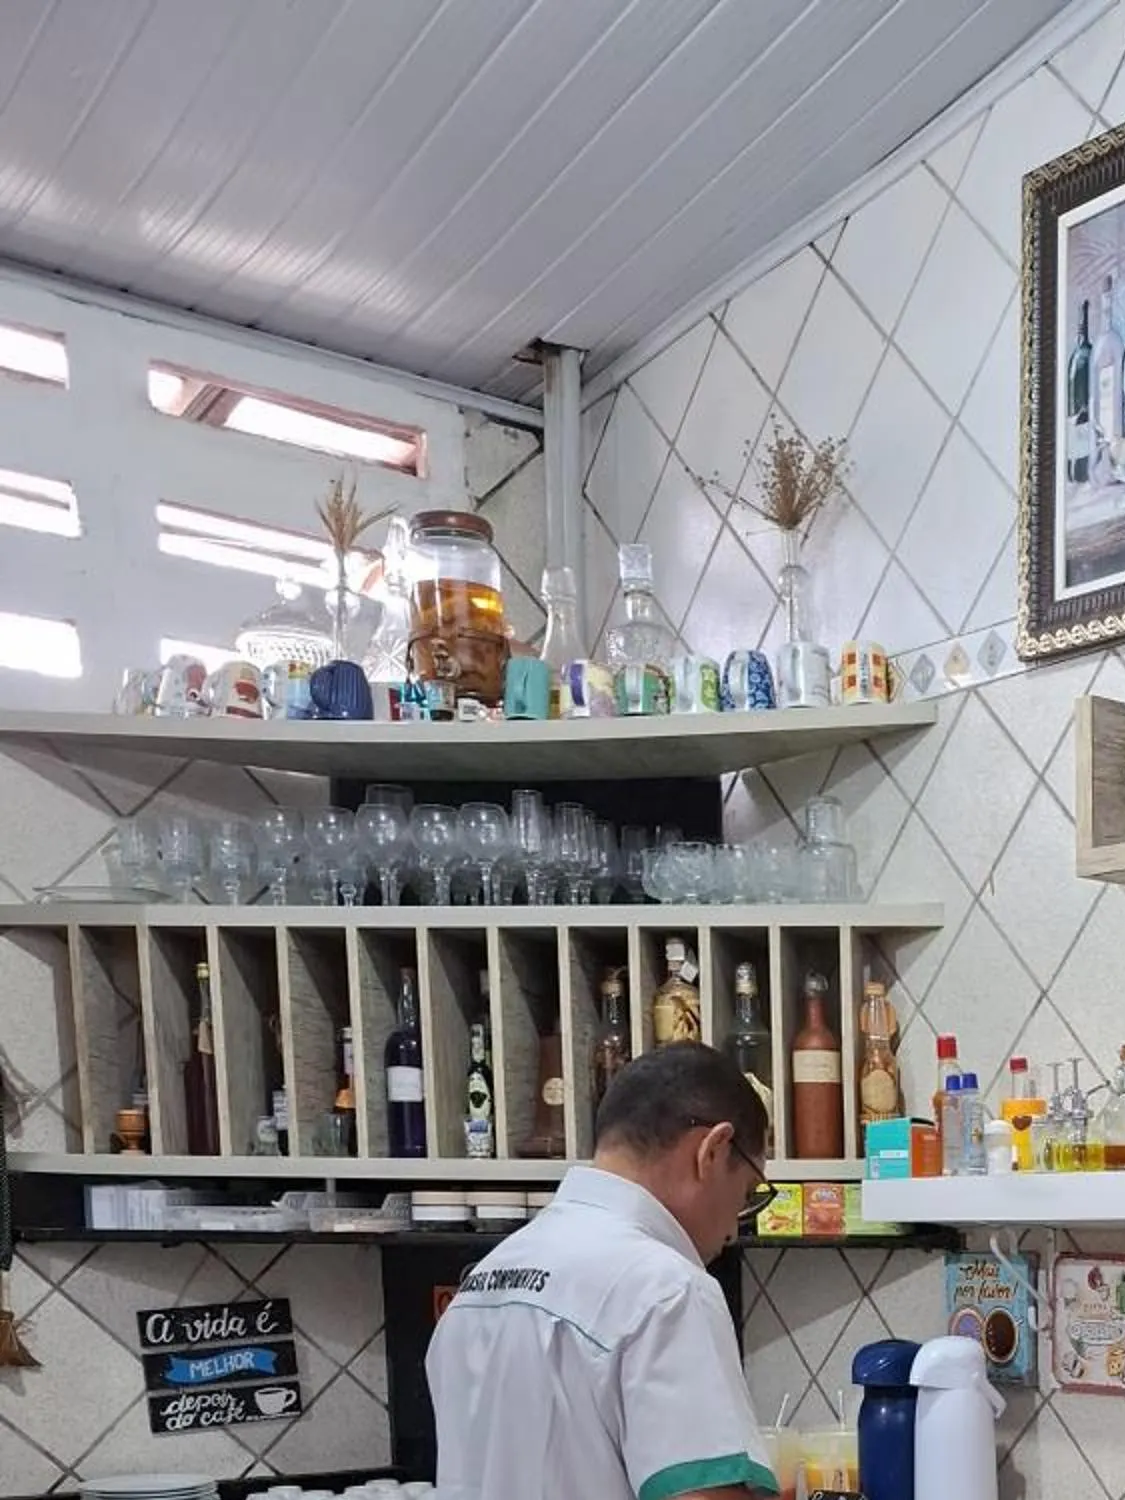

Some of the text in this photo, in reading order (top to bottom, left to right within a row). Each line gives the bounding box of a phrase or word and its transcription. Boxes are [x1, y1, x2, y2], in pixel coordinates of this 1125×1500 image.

[182, 1307, 247, 1341] vida
[256, 1301, 279, 1333] é
[189, 1352, 255, 1379] MELHOR
[160, 1389, 236, 1416] depois
[166, 1411, 197, 1431] do
